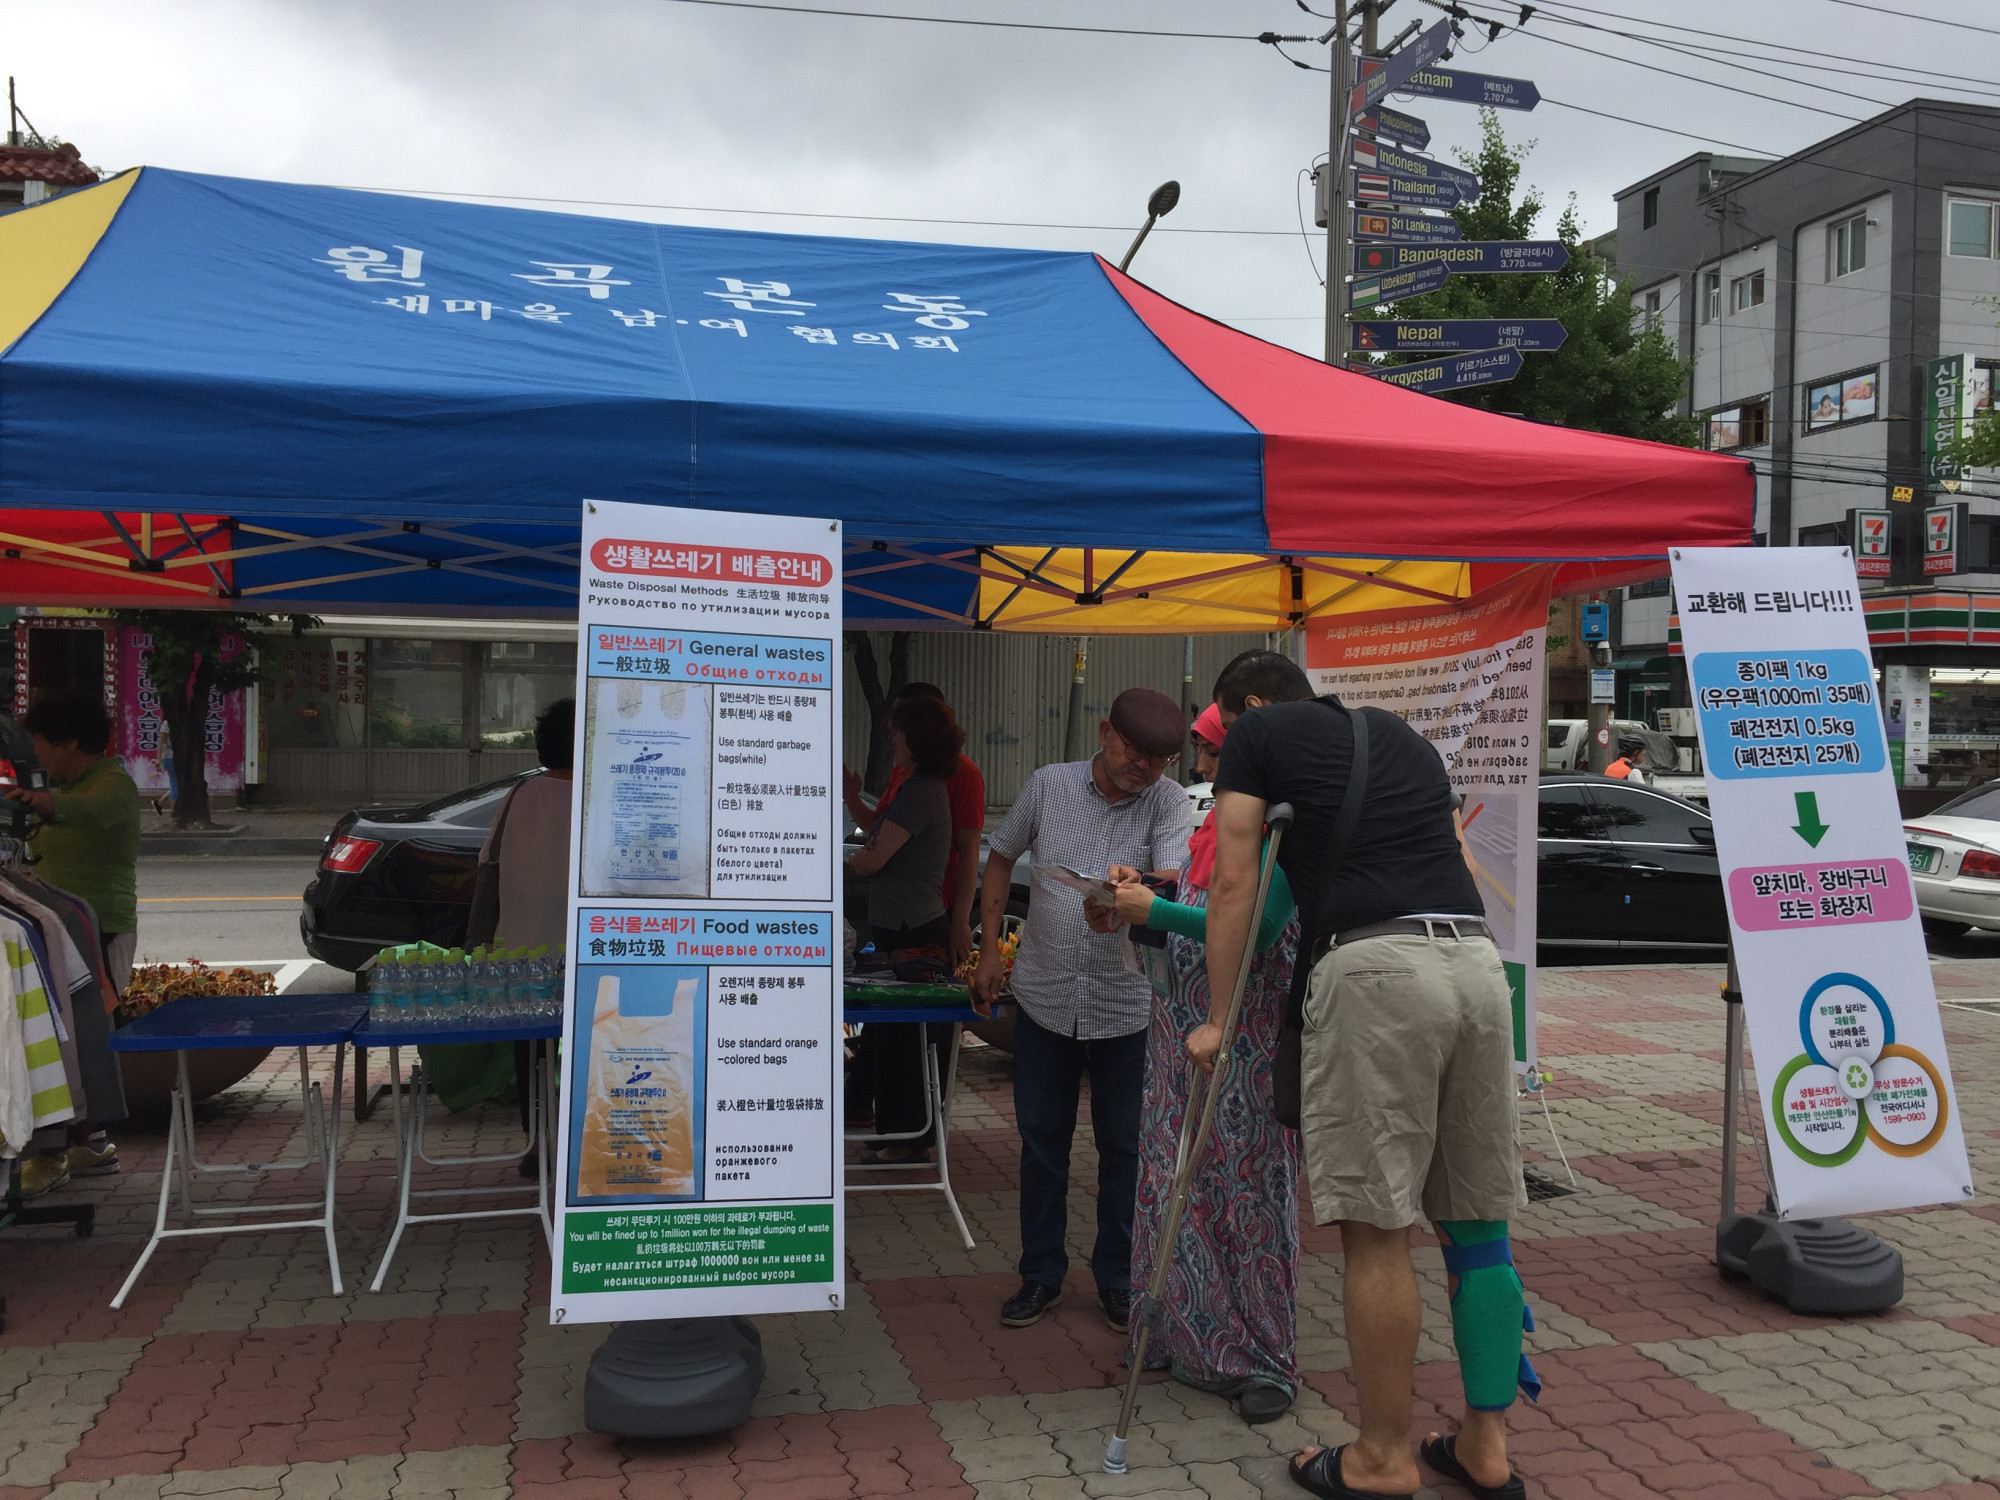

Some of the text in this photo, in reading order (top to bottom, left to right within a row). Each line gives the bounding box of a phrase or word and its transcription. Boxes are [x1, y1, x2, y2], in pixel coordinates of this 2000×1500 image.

[1367, 71, 1388, 94] China
[1409, 71, 1453, 89] etnam
[1484, 80, 1514, 94] (베트남)
[1379, 150, 1428, 176] Indonesia
[1392, 179, 1436, 195] Thailand
[1391, 217, 1431, 233] Sri Lanka
[1399, 247, 1484, 263] Bangladesh
[1500, 247, 1554, 258] (방글라데시)
[1381, 270, 1416, 291] Uzbekistan
[372, 294, 571, 324] 새마을
[786, 325, 959, 352] 협의회
[1397, 326, 1443, 342] Nepal
[1498, 326, 1525, 337] (네팔)
[1456, 353, 1510, 373] (키르기스스탄)
[603, 544, 823, 583] 생활쓰레기 배출안내
[589, 578, 729, 597] Waste Disposal Methods
[736, 587, 831, 605] 生活垃圾 排放向导
[1687, 590, 1854, 614] 교환해 드립니다!!!
[588, 594, 831, 622] Руководство по утилизации мусора
[598, 633, 684, 655] 일반쓰레기
[689, 639, 826, 663] General wastes
[597, 655, 672, 676] 一般垃圾
[685, 662, 824, 685] Общие отходы
[1737, 660, 1828, 682] 종이팩 1kg
[719, 691, 817, 708] 일반쓰레기는 반드시 종량제
[1700, 683, 1872, 711] (우우팩1000ml 35매)
[759, 710, 793, 723] 사용 배출
[1729, 717, 1855, 740] 폐건전지 0.5kg
[718, 737, 812, 752] Use standard garbage
[718, 753, 767, 766] bags(white)
[1733, 742, 1860, 769] (폐건전지 25개)
[717, 828, 818, 841] Общие отходы должны
[717, 844, 815, 856] быть только пакетах
[717, 857, 784, 870] (белого цвета)
[717, 872, 788, 883] для утилизации
[1752, 866, 1888, 897] 앞치마, 장바구니
[1779, 894, 1874, 921] 또는 화장지
[588, 915, 696, 935] 음식물쓰레기
[703, 918, 819, 935] Food wastes
[588, 937, 666, 958] 食物垃圾
[676, 941, 826, 959] Пищевые отходы
[718, 976, 806, 989] 오렌지색 종량제 봉투
[718, 993, 759, 1006] 사용 배출
[1819, 1003, 1868, 1016] 환경을 살리는
[1833, 1015, 1857, 1026] 재활용
[1828, 1026, 1867, 1039] 분리배출은
[717, 1038, 819, 1051] Use standard orange
[1828, 1037, 1870, 1050] 나부터 실천
[763, 1054, 788, 1066] bags
[1799, 1085, 1838, 1098] 생활쓰레기
[1873, 1076, 1923, 1091] 무상 방문수거
[1873, 1088, 1928, 1102] 대형 폐가전제품
[1790, 1100, 1807, 1111] 배출
[1879, 1101, 1926, 1115] 전국어디서나
[1882, 1111, 1927, 1125] 1599-0903
[1804, 1120, 1846, 1133] 시작입니다.
[715, 1143, 794, 1154] использование
[715, 1156, 778, 1168] оранжевого
[715, 1171, 751, 1181] пакета
[606, 1211, 757, 1227] 쓰레기 무단투기 100만원 이하의 과태료가
[569, 1223, 830, 1243] You will be fined up to 1million won for the illegal dumping of waste
[572, 1252, 826, 1273] Будет налагаться штраф 1000000 вон или менее за
[603, 1269, 796, 1288] несанкционированный выброс мусора
